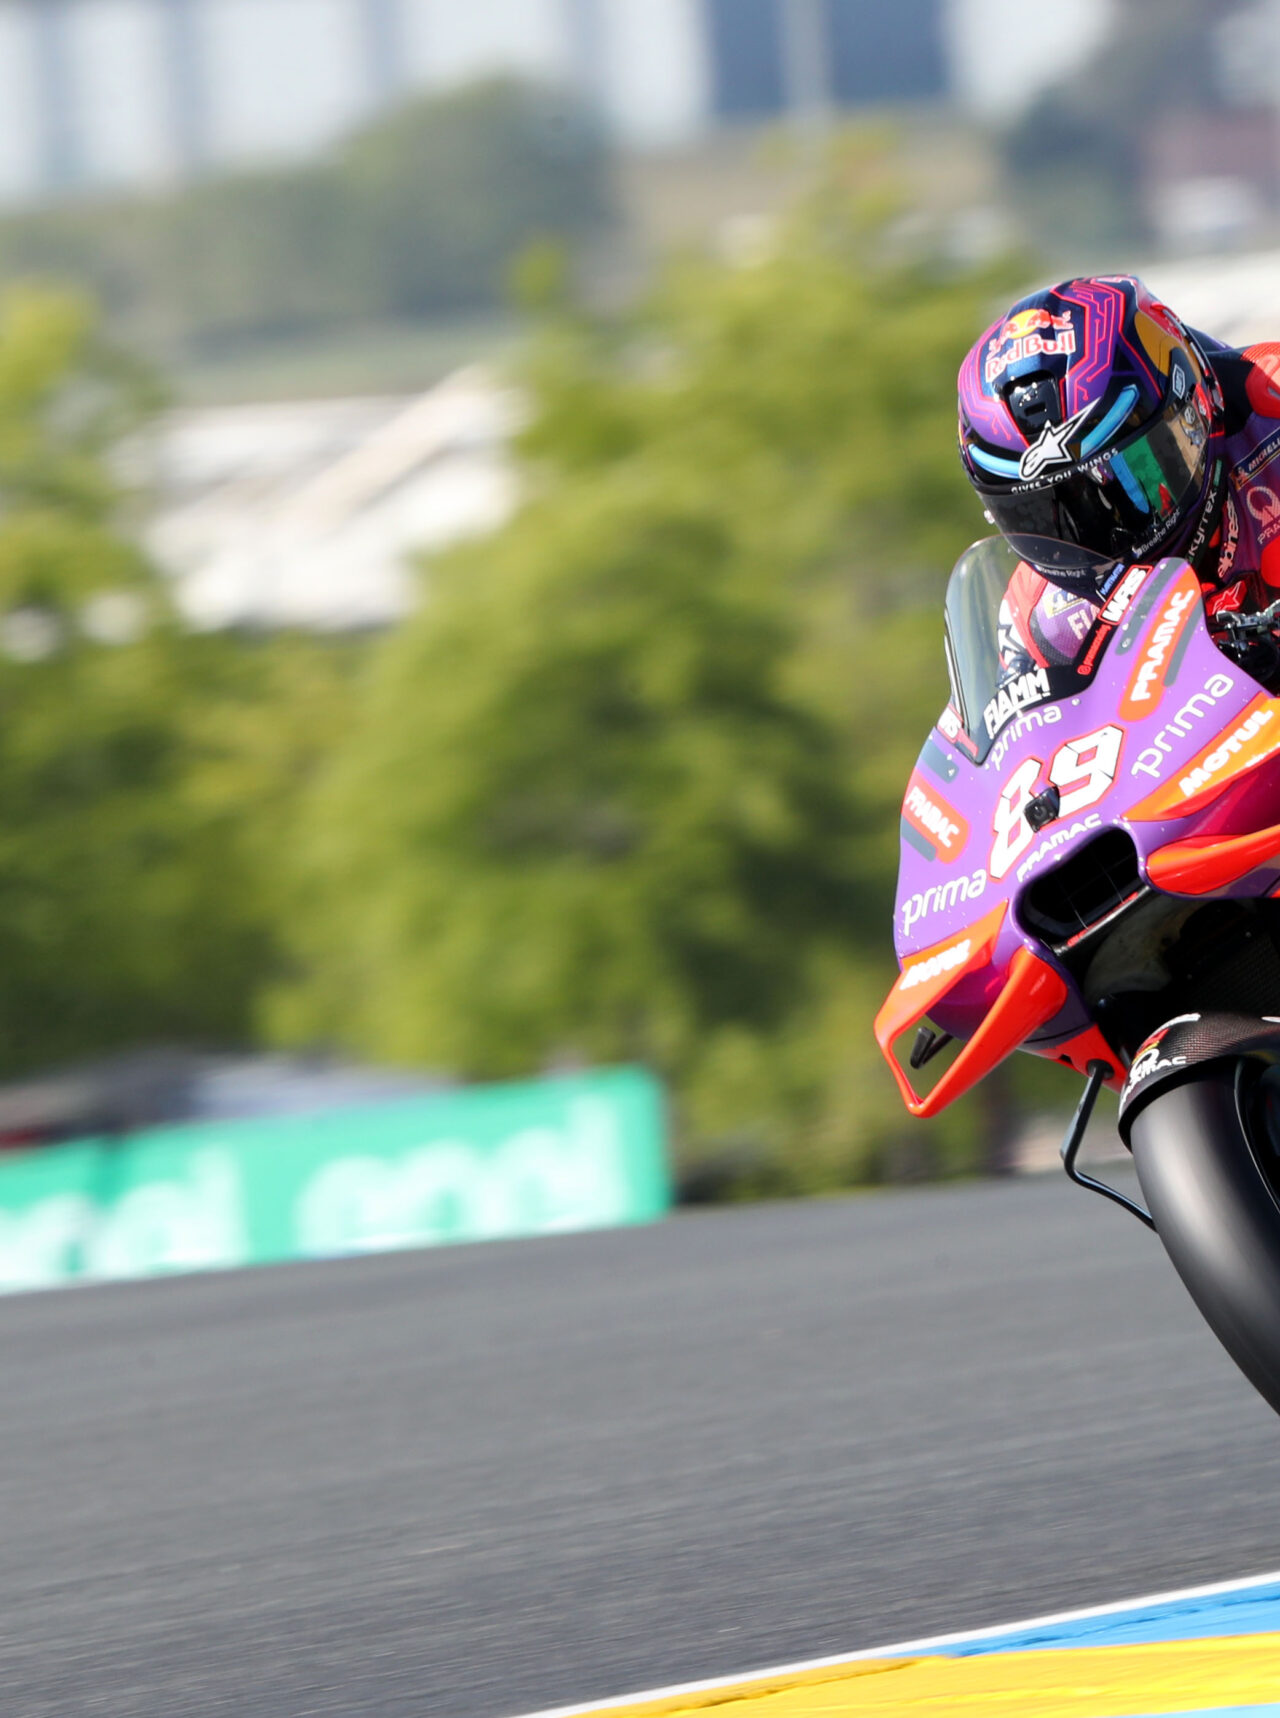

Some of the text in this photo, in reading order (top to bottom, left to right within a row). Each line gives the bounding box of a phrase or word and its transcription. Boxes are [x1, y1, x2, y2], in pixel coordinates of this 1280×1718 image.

[985, 328, 1077, 382] Red Bull
[1077, 447, 1119, 473] WINGS
[1132, 589, 1195, 702] PRAMAC
[983, 667, 1051, 740] FIAMM
[990, 705, 1062, 772] prima
[1131, 673, 1235, 779] prima
[1178, 709, 1275, 798] MOTUL
[988, 722, 1126, 880] 89
[1016, 812, 1103, 884] PRAMAC
[901, 868, 988, 937] prima
